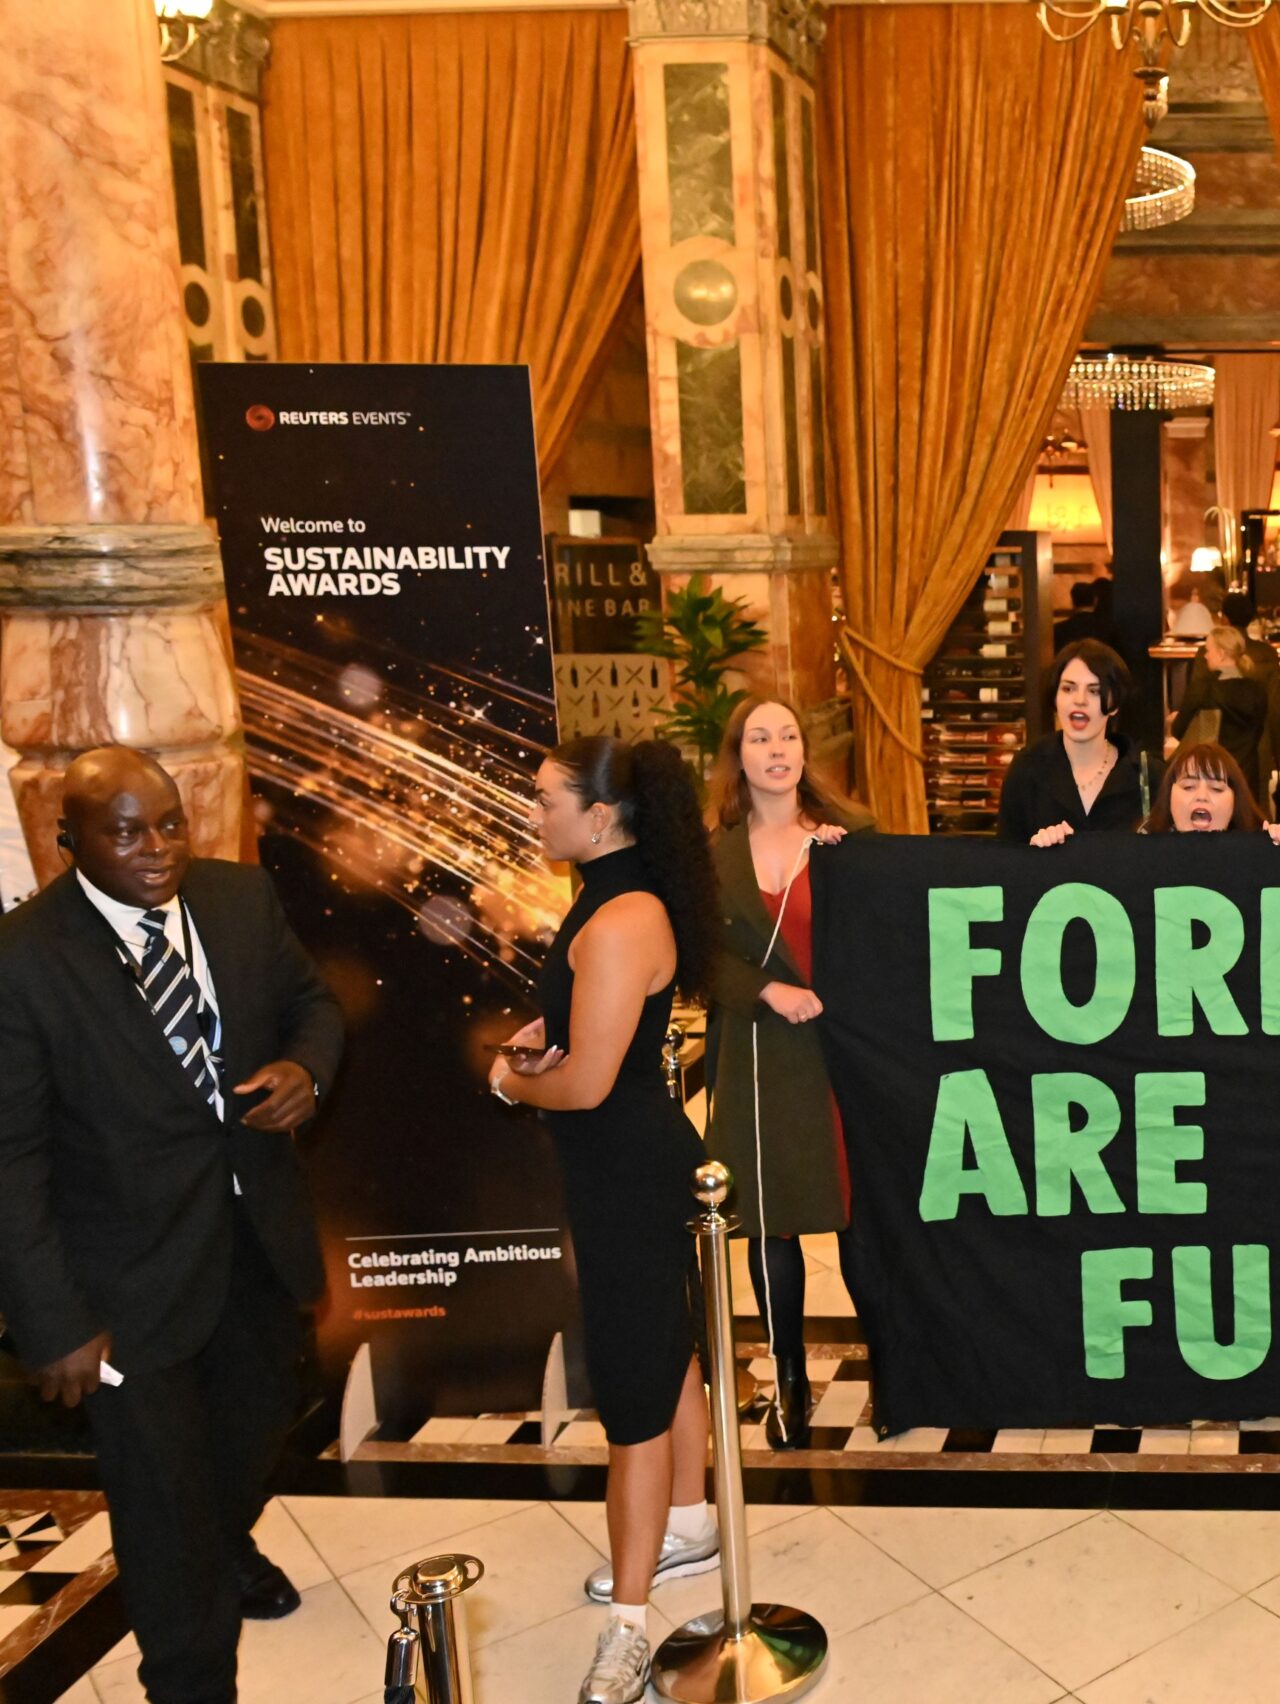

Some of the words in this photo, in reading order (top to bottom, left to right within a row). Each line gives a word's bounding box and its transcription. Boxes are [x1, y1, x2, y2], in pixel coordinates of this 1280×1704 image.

[279, 411, 349, 425] REUTERS
[260, 516, 344, 534] Welcome
[347, 518, 366, 533] to
[263, 546, 511, 571] SUSTAINABILITY
[268, 572, 401, 597] AWARDS
[554, 562, 621, 586] RILL
[629, 562, 648, 586] &
[549, 598, 596, 617] INE
[919, 1069, 1208, 1221] ARE
[347, 1248, 460, 1268] Celebrating
[463, 1244, 562, 1263] Ambitious
[350, 1267, 457, 1288] Leadership
[353, 1305, 446, 1320] #sustawards
